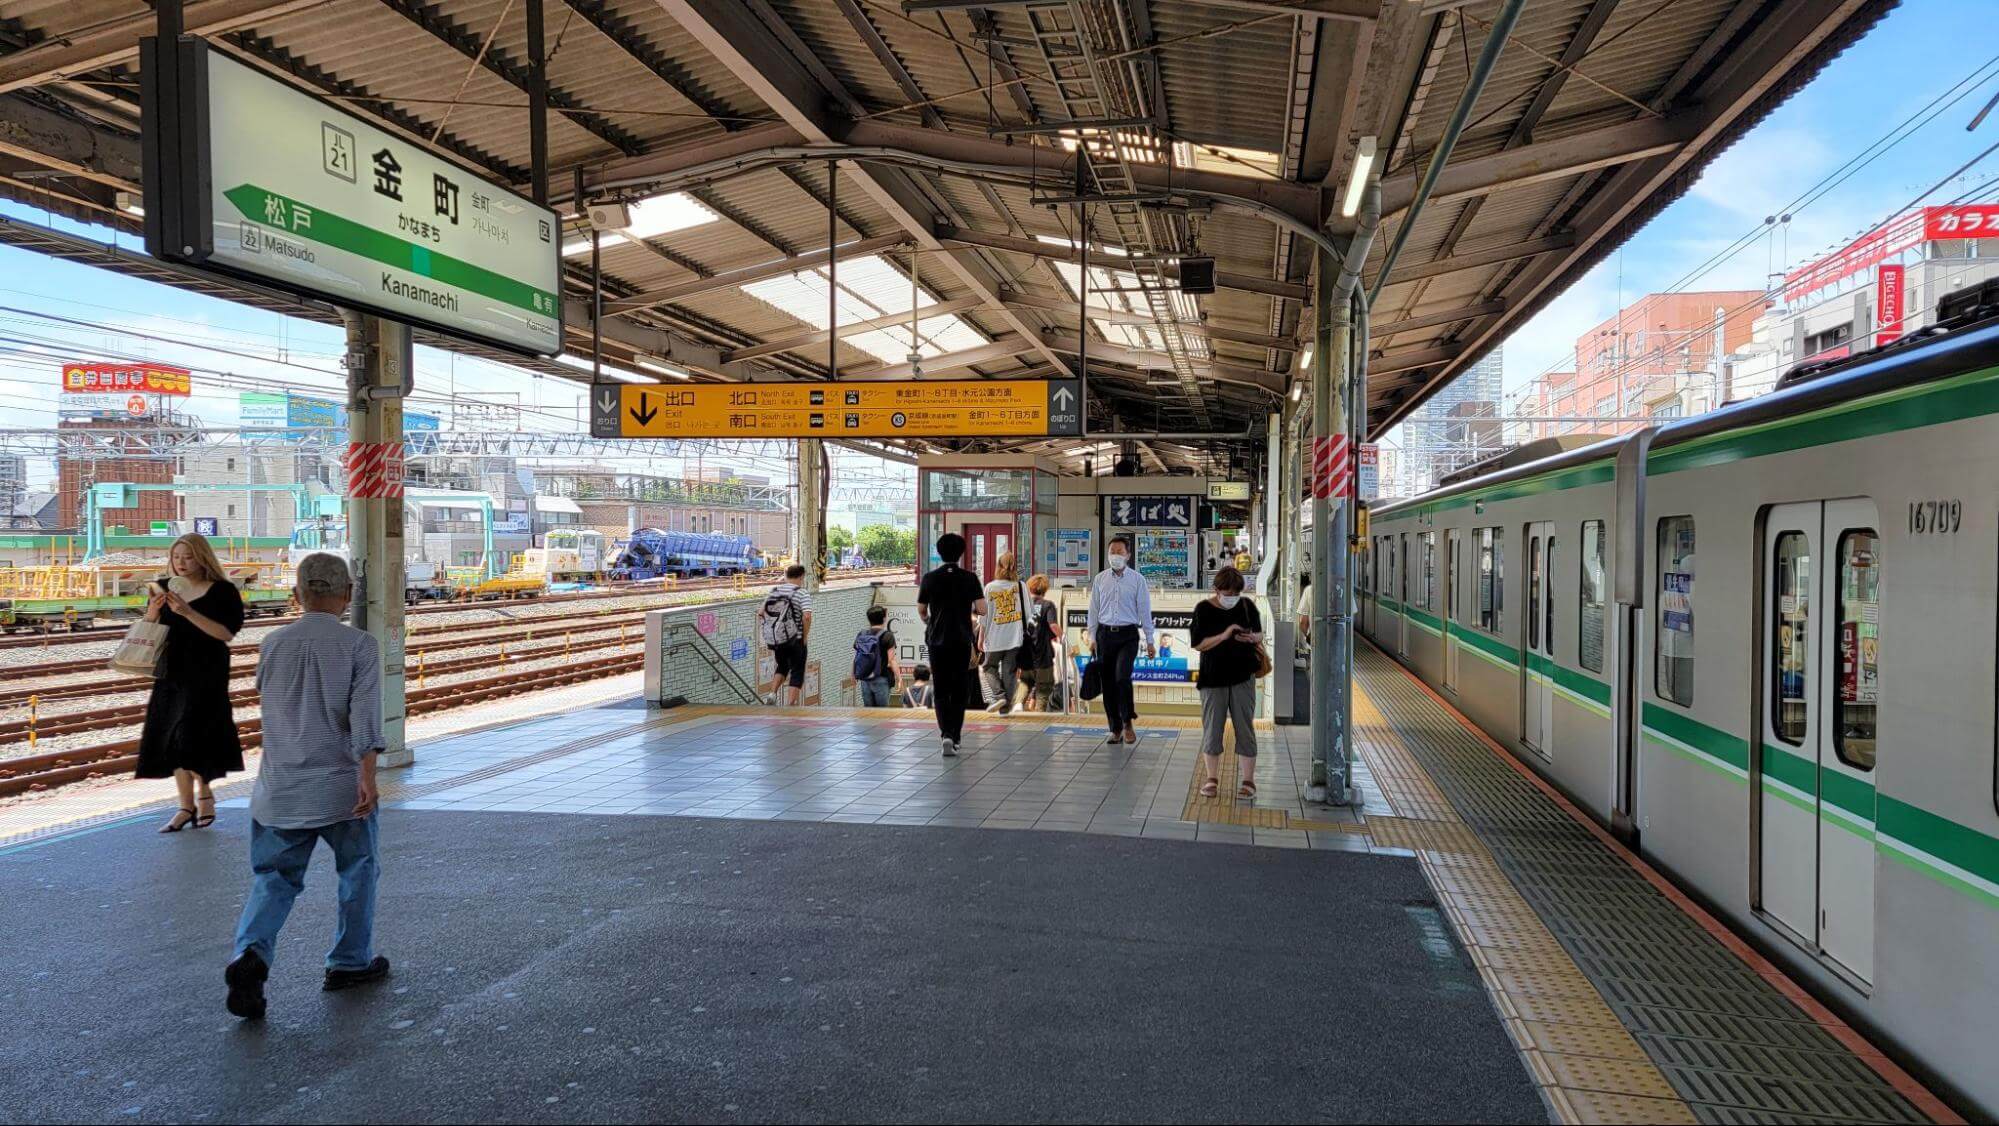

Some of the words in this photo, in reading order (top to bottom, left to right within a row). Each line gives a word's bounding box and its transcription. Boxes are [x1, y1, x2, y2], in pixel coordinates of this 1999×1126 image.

[335, 133, 344, 150] JL
[331, 148, 347, 171] 21
[372, 148, 459, 225] 金町
[264, 194, 312, 231] 松戸
[398, 212, 440, 243] かなまち
[245, 235, 257, 247] 22
[265, 235, 315, 263] Matsudo
[382, 271, 458, 312] Kanamachi
[666, 391, 695, 406] 出口
[729, 391, 757, 406] 北口
[597, 417, 617, 425] おり口
[666, 409, 682, 418] Exit
[730, 414, 757, 428] 南口
[1050, 414, 1075, 423] のぼり口
[1117, 500, 1189, 525] そば処
[1909, 499, 1961, 534] 16709
